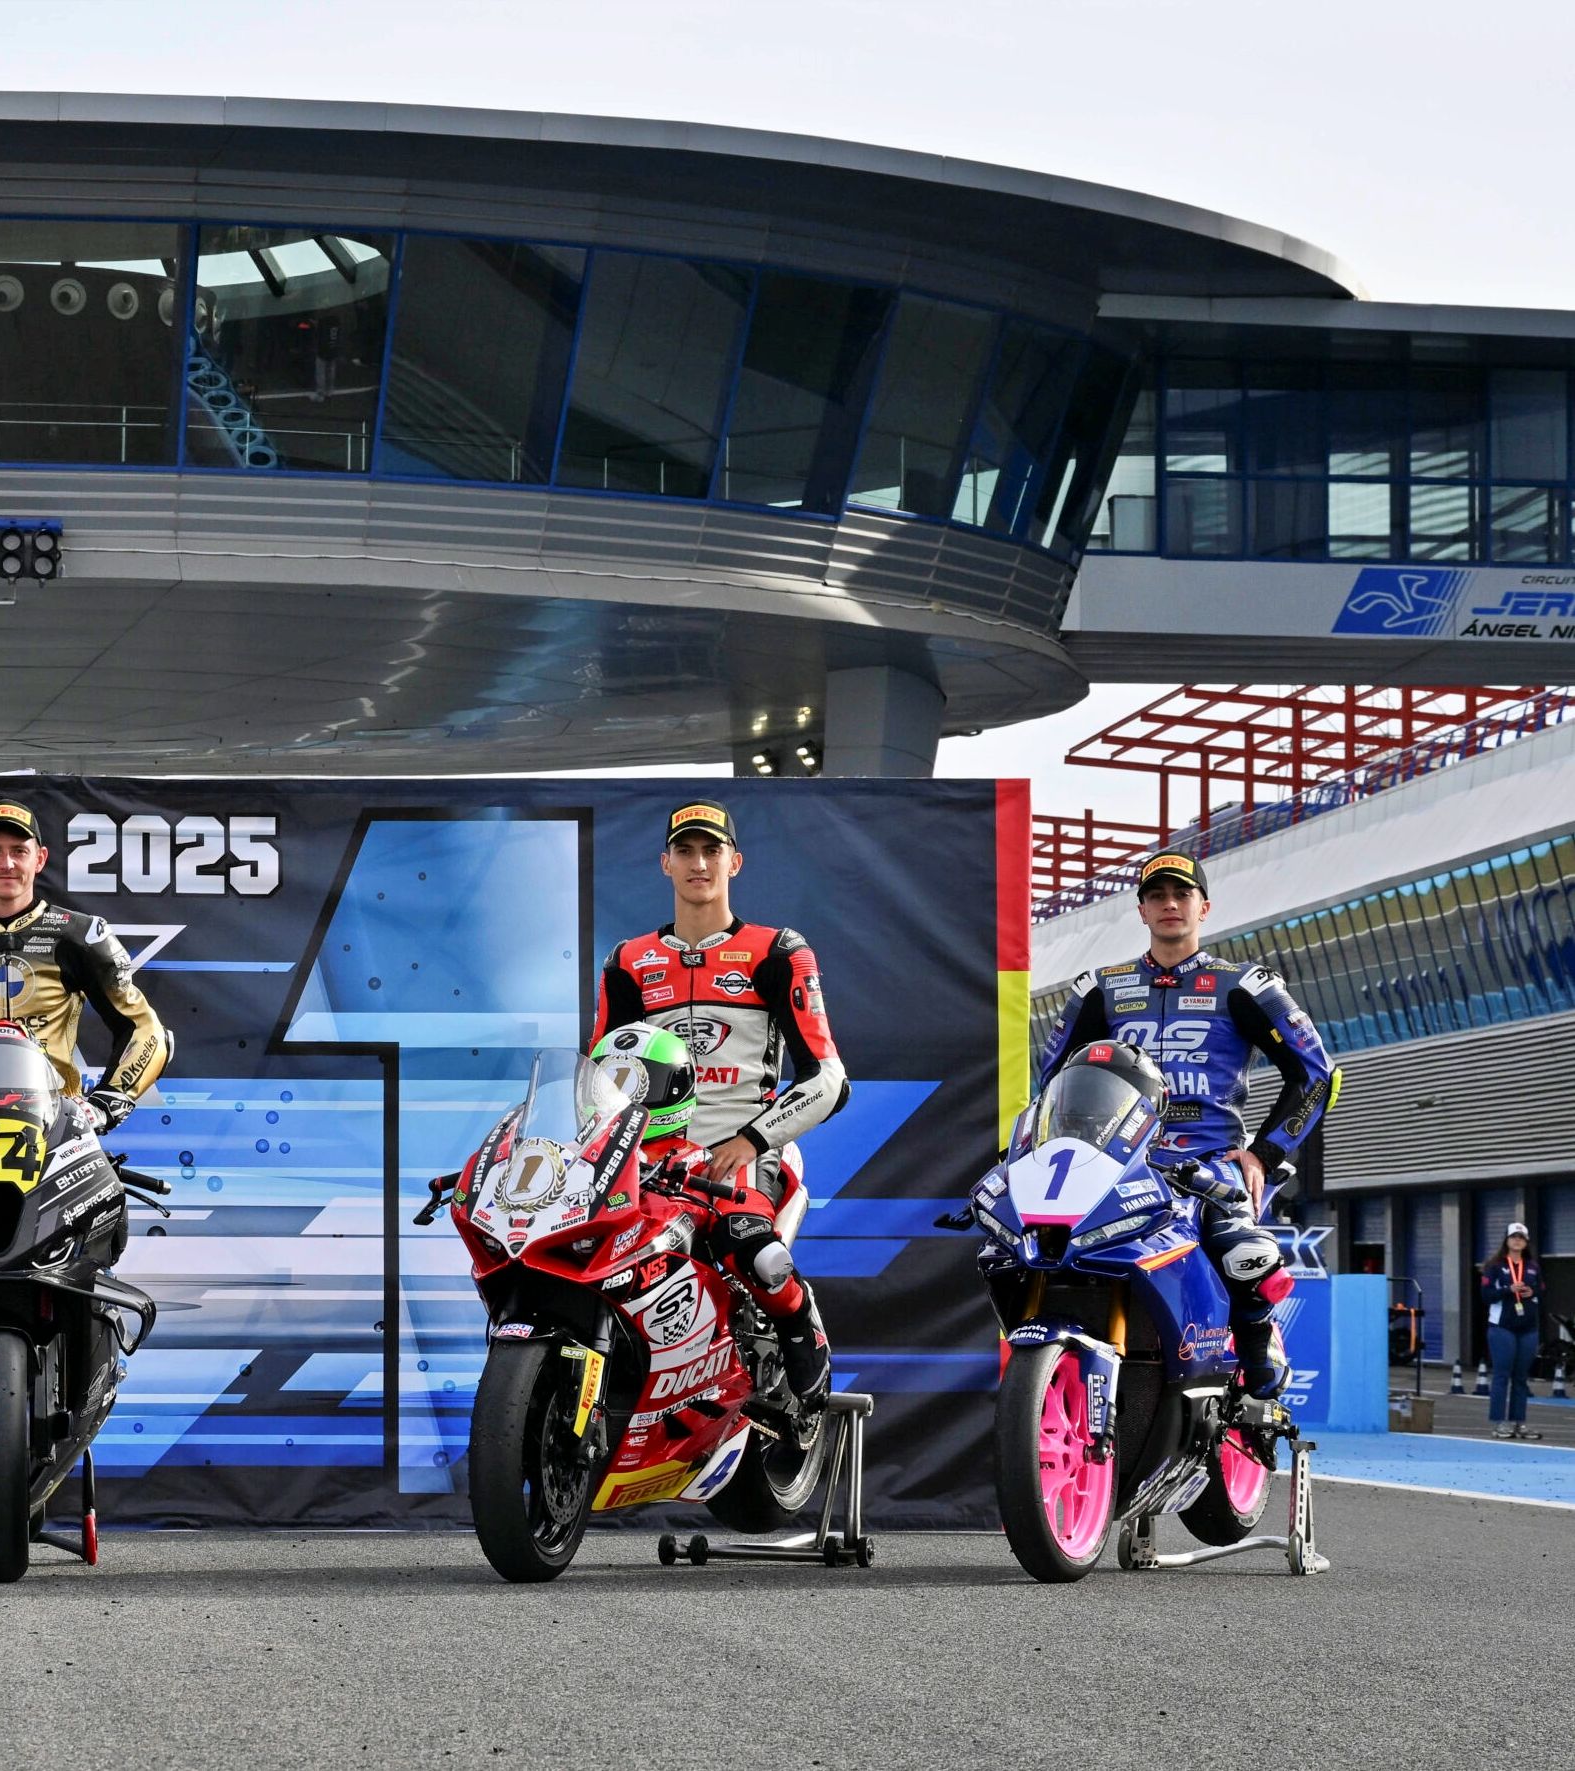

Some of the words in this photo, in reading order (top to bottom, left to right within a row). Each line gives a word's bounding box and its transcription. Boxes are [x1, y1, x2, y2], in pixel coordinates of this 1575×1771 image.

[1472, 591, 1575, 616] JER
[1461, 619, 1542, 638] ÁNGEL
[675, 808, 720, 824] PIRELLI
[67, 813, 279, 895] 2025
[1145, 859, 1189, 876] PIRELLI
[1164, 1072, 1210, 1096] AHA
[766, 1109, 793, 1129] SPEED
[796, 1090, 824, 1113] RACING
[577, 1118, 596, 1144] Puig
[595, 1149, 624, 1194] SPEED
[619, 1110, 643, 1149] RACING
[472, 1146, 491, 1194] RACING
[512, 1155, 543, 1195] 1
[1044, 1149, 1075, 1200] 1
[569, 1190, 590, 1208] 26
[976, 1190, 997, 1211] YAMAHA
[1119, 1193, 1159, 1214] YAMAHA
[561, 1208, 585, 1221] REDD
[615, 1220, 644, 1245] LIQUI
[613, 1237, 639, 1257] MOLY
[601, 1269, 634, 1291] REDD
[640, 1255, 668, 1290] YSS
[498, 1330, 529, 1338] MOLY
[1009, 1332, 1045, 1341] YAMAHA
[582, 1358, 600, 1410] PIRELLI
[649, 1343, 733, 1400] DUCATI
[1088, 1373, 1103, 1433] PIRELLI
[604, 1463, 689, 1508] PIRELLI
